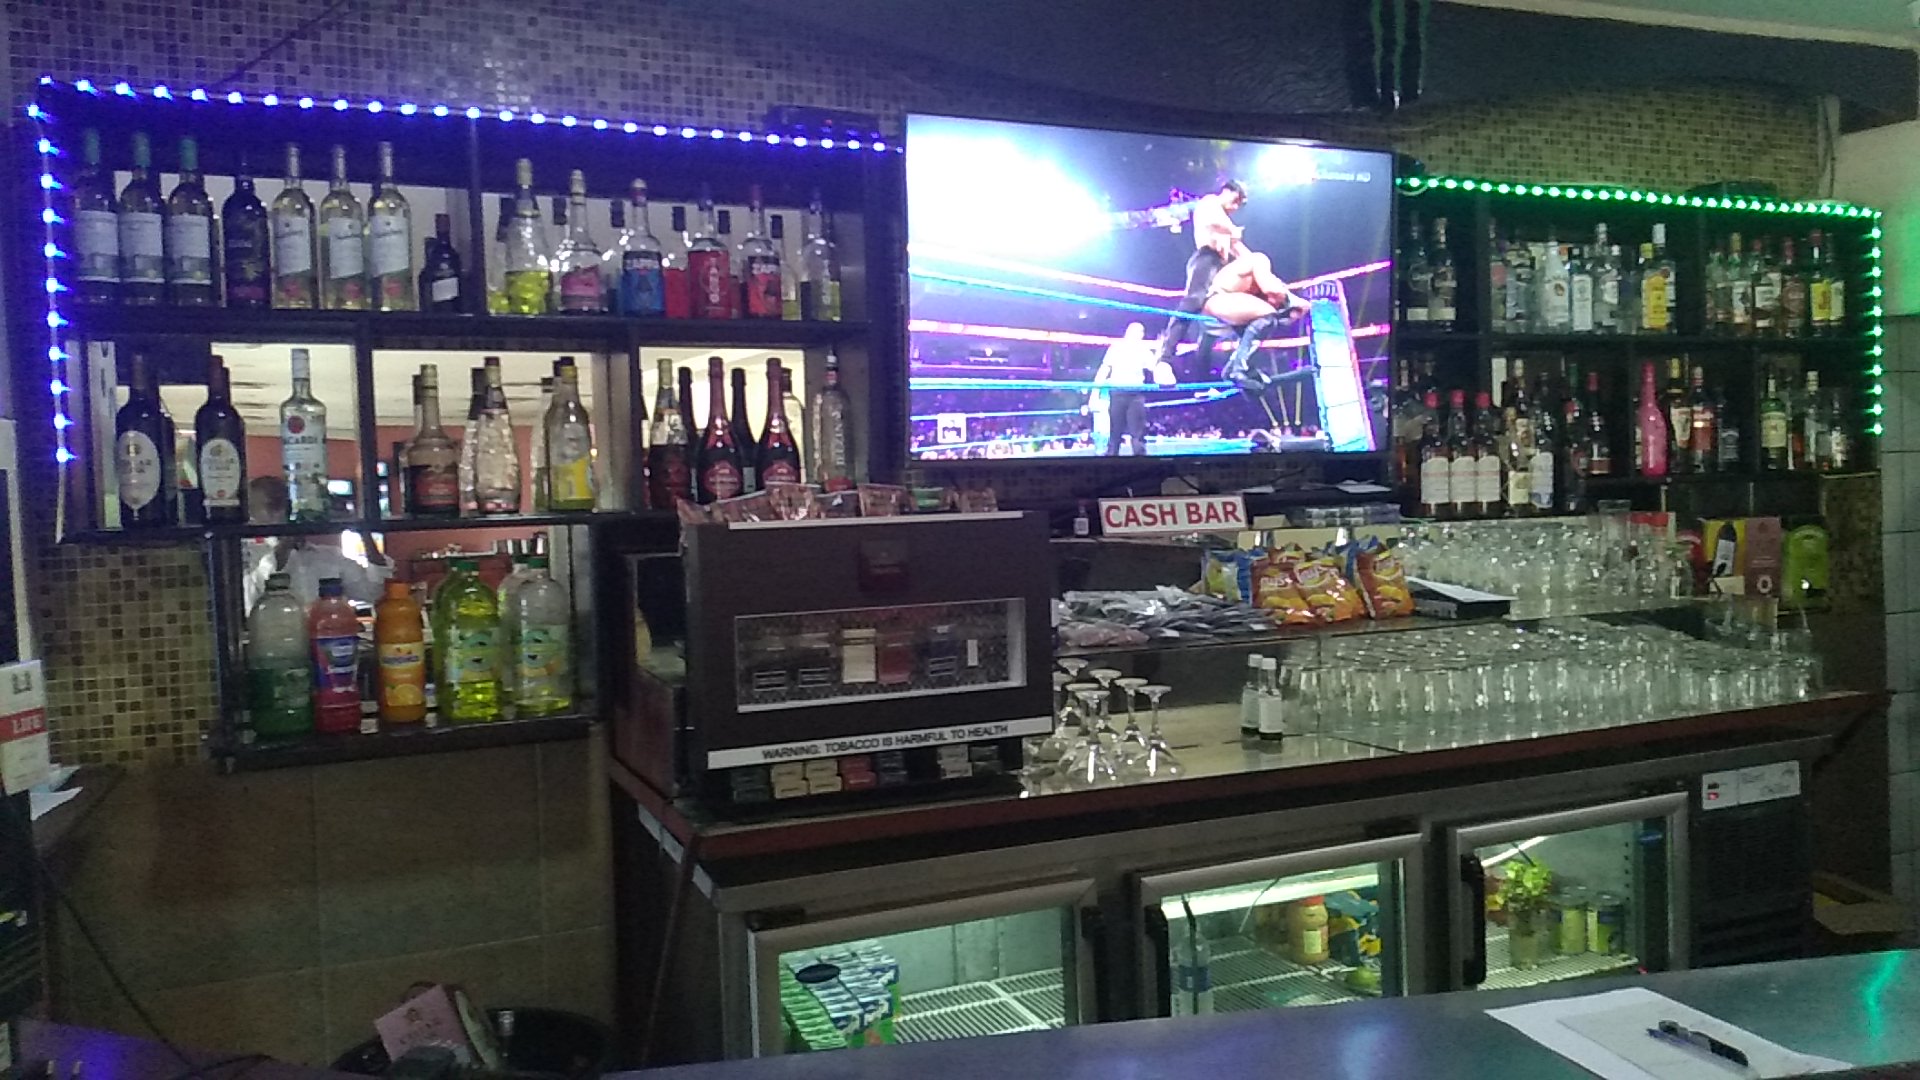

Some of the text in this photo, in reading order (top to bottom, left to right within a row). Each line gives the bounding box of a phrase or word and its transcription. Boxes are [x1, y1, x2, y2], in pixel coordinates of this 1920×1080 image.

[1105, 501, 1242, 528] CASH BAR
[762, 725, 1009, 759] WARNING: TOBACCO IS HARMFUL TO HEALTH
